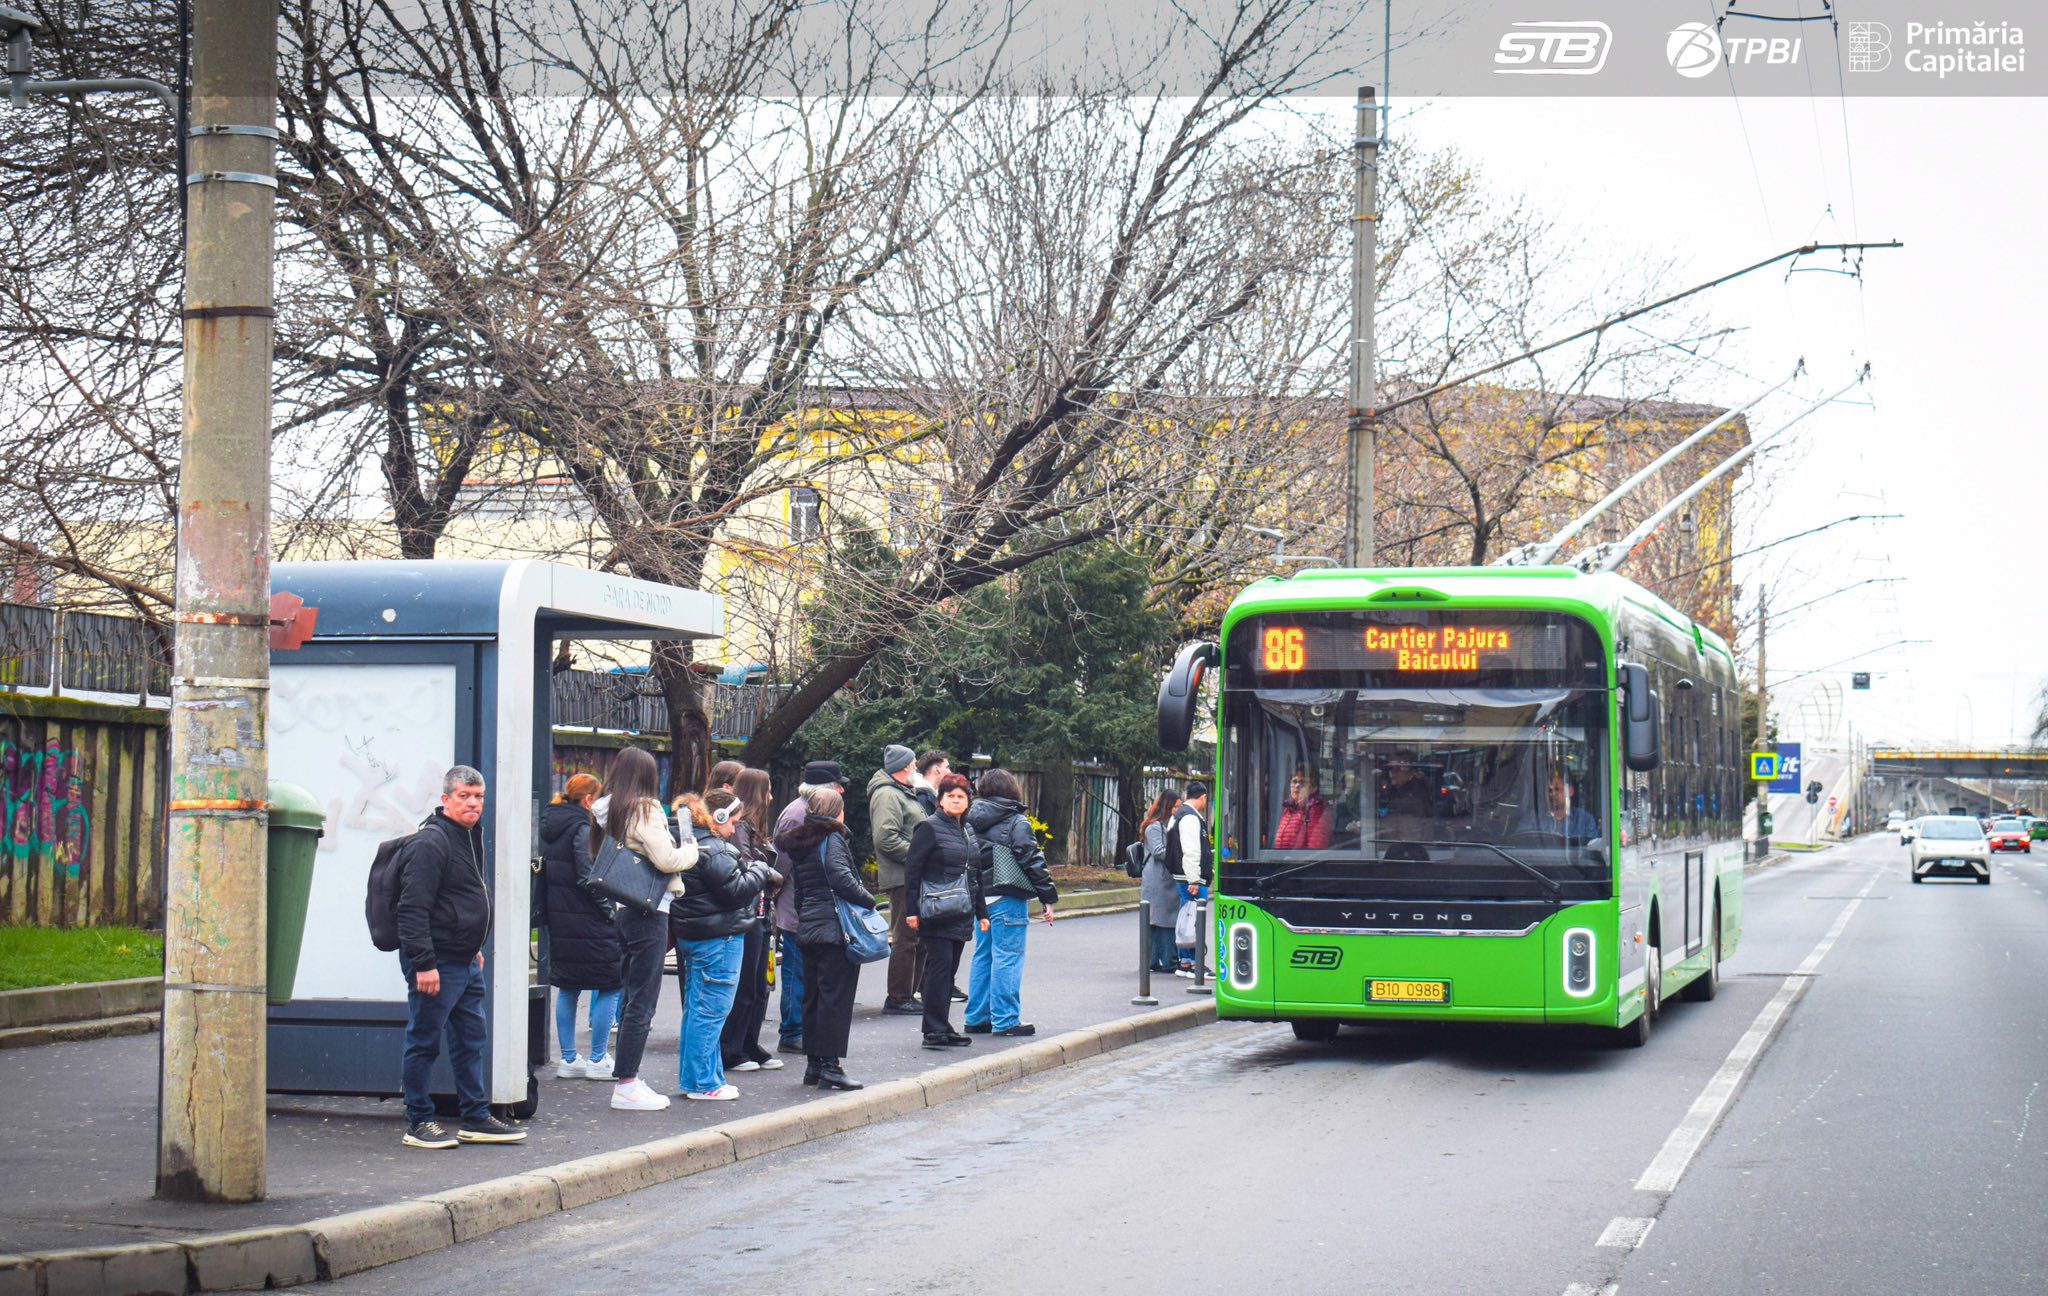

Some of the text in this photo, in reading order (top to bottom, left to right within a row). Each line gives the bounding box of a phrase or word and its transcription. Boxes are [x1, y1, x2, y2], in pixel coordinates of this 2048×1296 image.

[603, 584, 673, 617] GARA DE NORD
[1264, 628, 1304, 670] 86
[1366, 628, 1508, 650] Cartier Pajura
[1398, 649, 1478, 670] Baicului
[1341, 911, 1473, 922] YUTONG
[1289, 949, 1339, 966] STB
[1375, 982, 1440, 998] B10 0986
